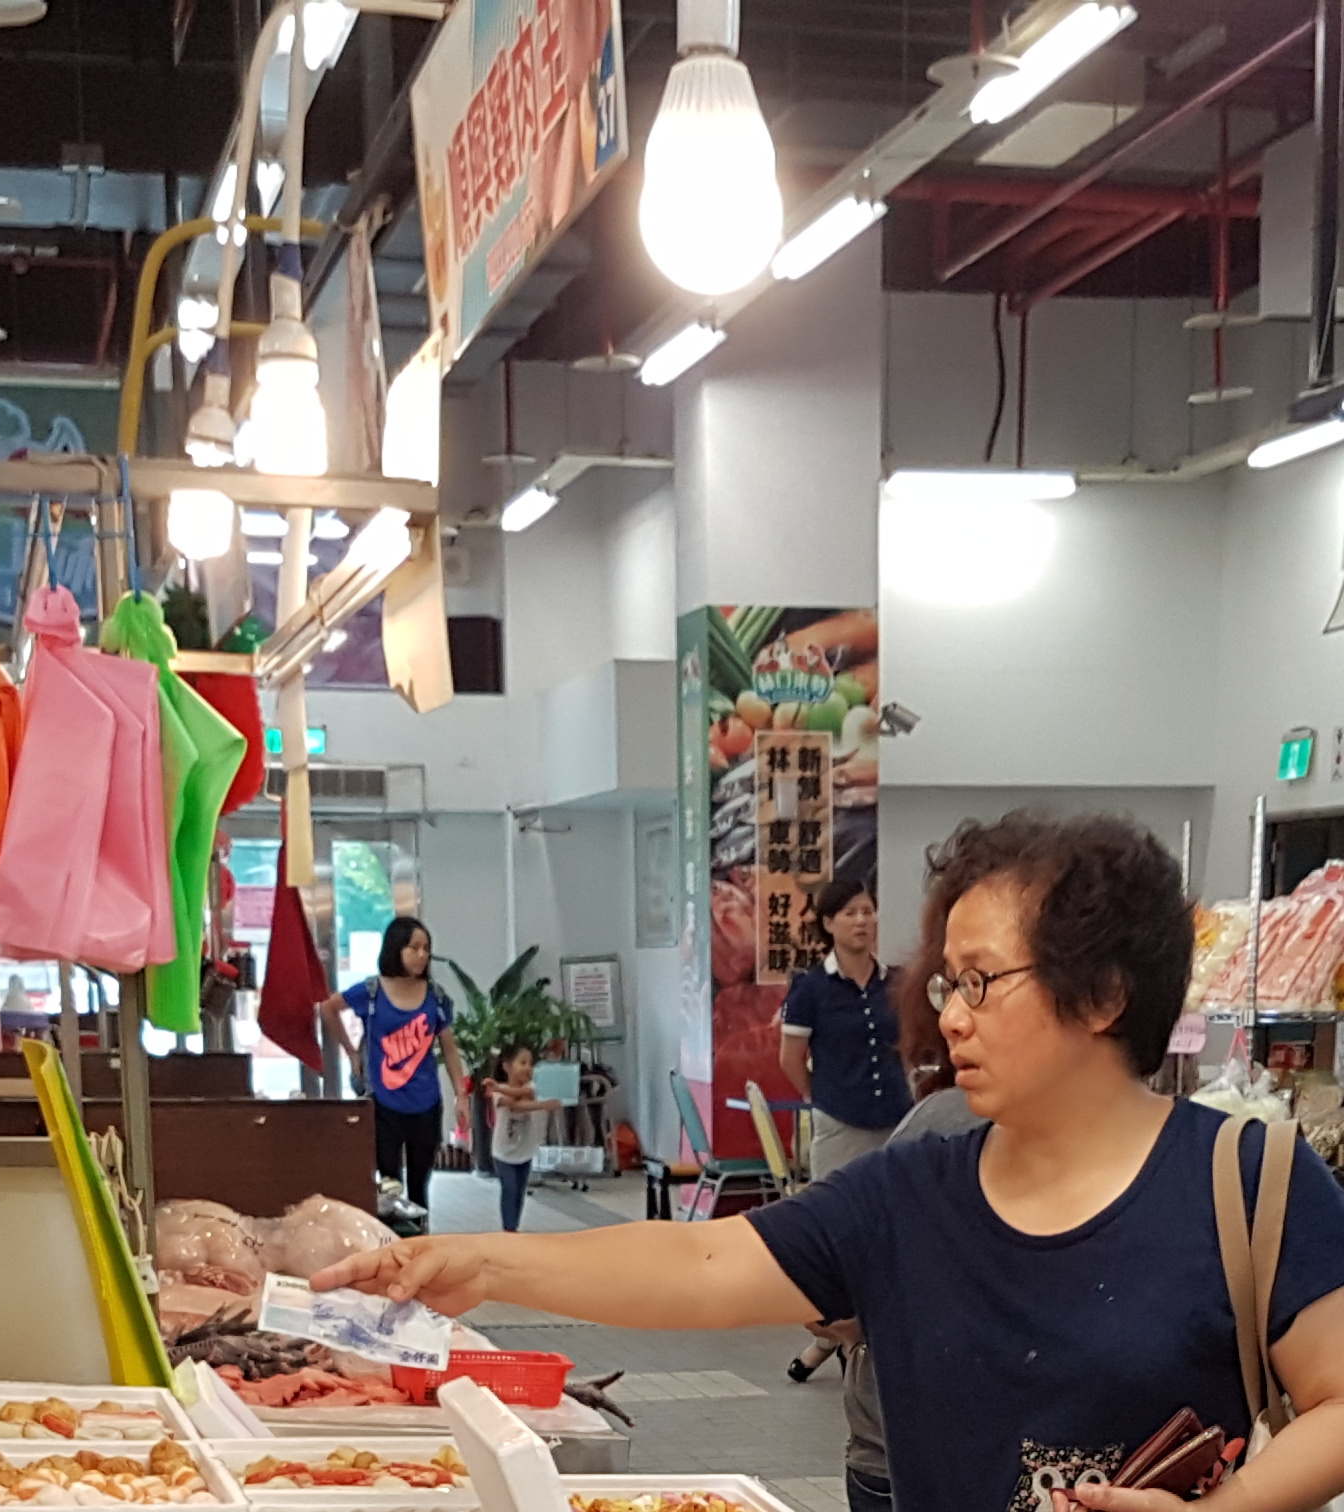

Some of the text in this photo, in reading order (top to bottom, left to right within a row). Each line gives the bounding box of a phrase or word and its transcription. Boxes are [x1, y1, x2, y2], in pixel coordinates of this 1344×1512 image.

[598, 79, 617, 147] 37
[768, 891, 792, 973] 好滋味
[381, 1013, 430, 1066] NIKE
